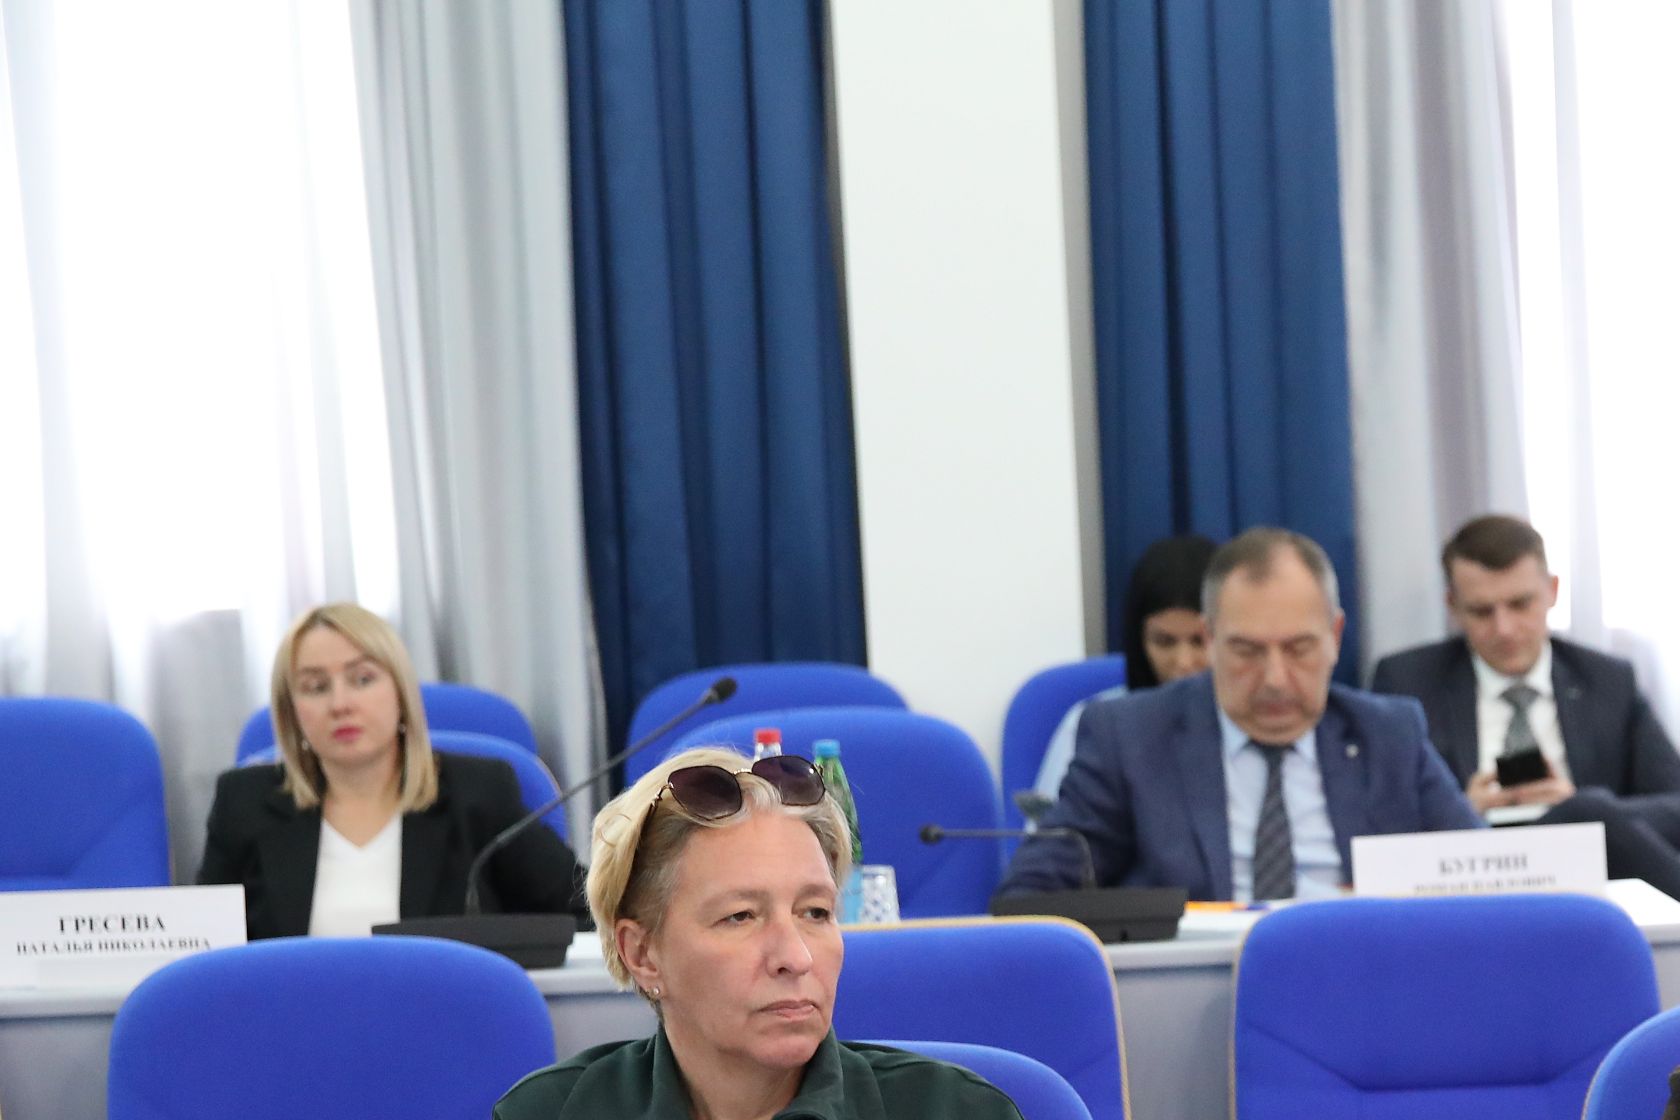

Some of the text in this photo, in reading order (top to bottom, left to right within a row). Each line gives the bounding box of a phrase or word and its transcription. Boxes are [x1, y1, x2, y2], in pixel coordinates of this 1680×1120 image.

[58, 914, 167, 934] ГРЕСЕВА
[15, 937, 211, 955] НАТАЛЬЯ НИКОЛАЕВНА
